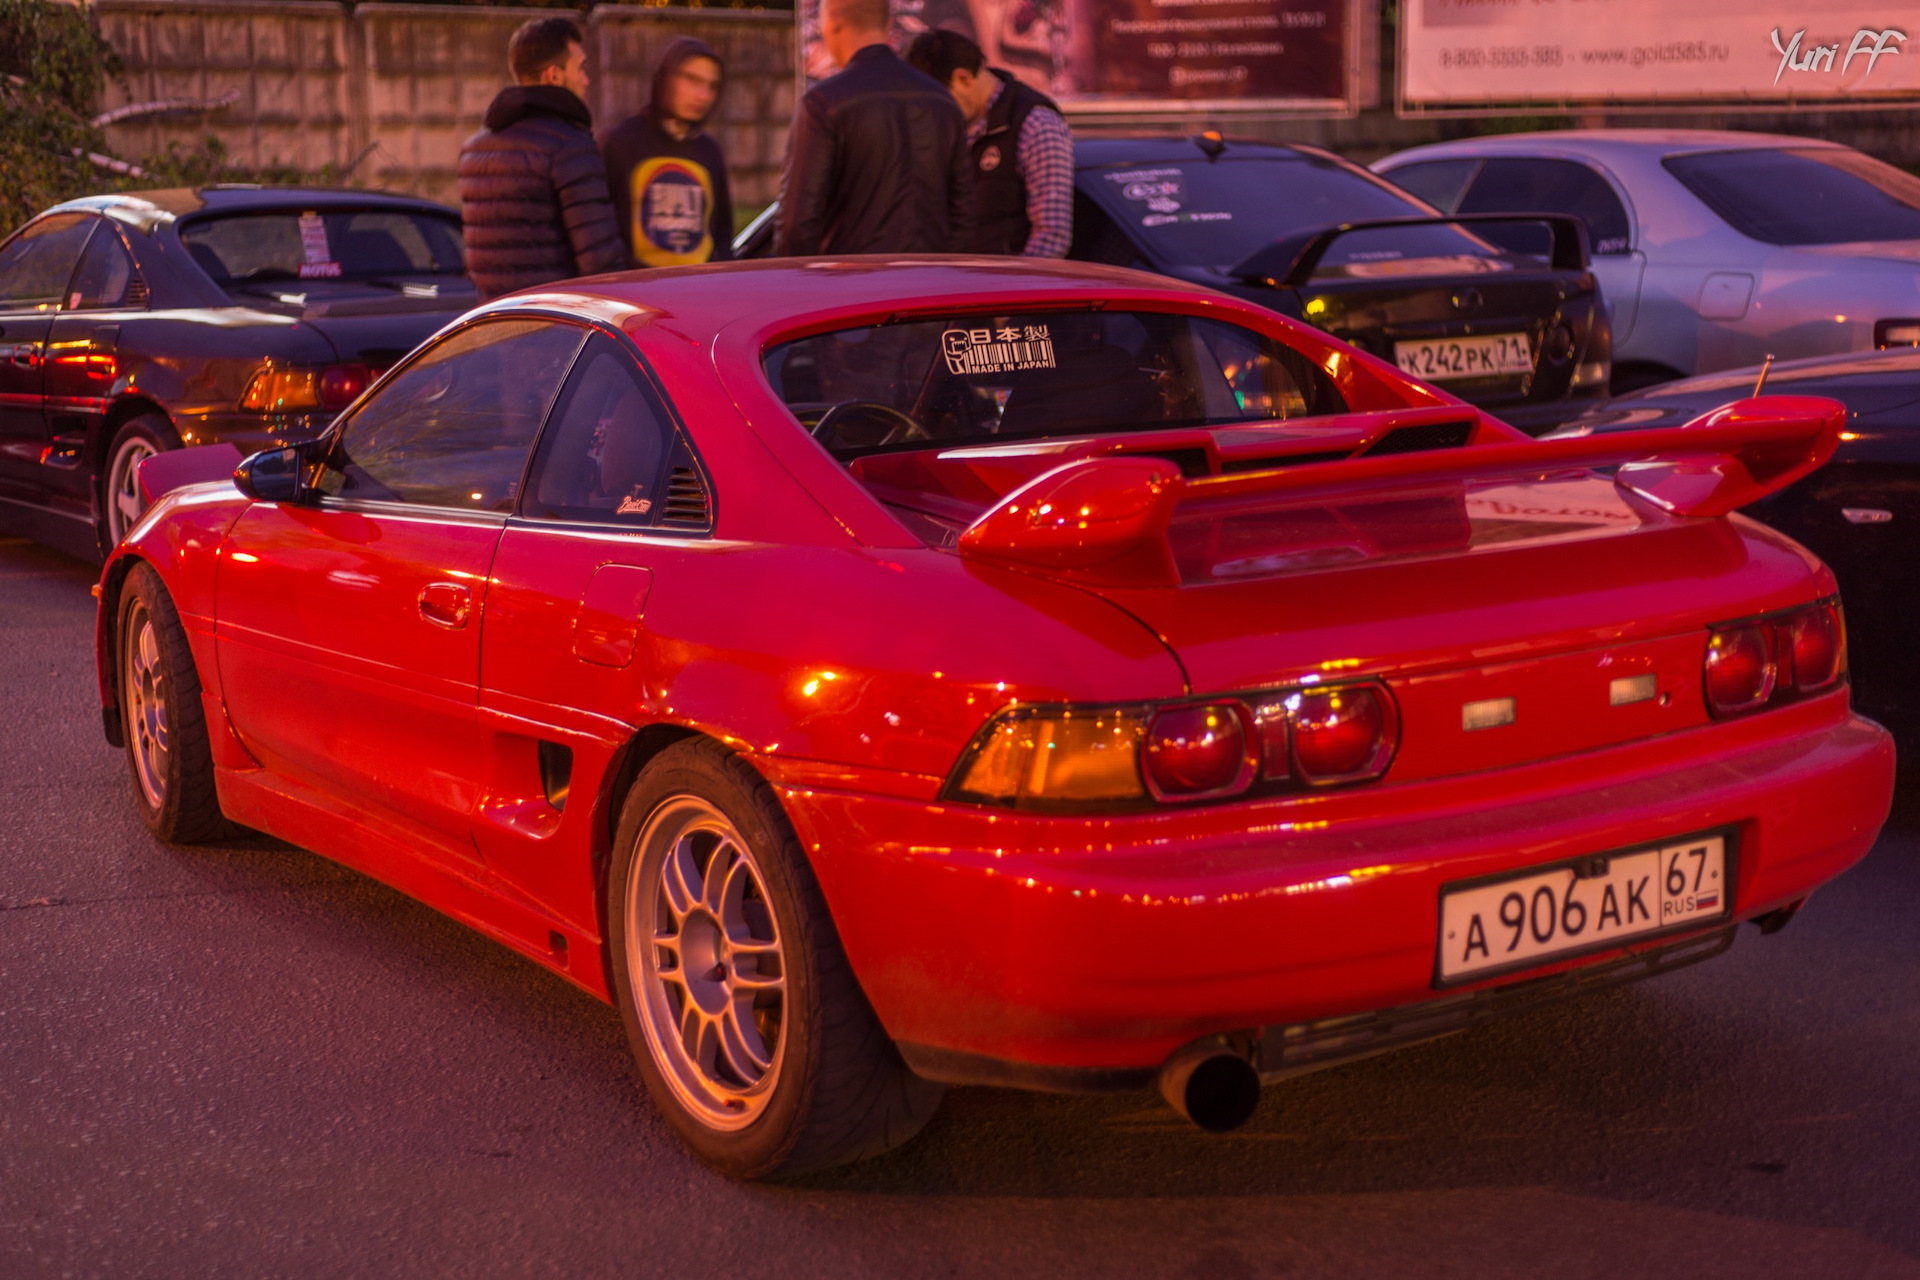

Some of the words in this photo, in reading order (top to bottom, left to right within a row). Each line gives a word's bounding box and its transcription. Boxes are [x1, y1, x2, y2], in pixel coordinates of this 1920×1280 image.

[1580, 41, 1730, 69] www.gold585.ru
[969, 324, 1051, 345] 日本製
[971, 363, 1001, 374] MADE
[1003, 361, 1015, 372] IN
[1017, 359, 1050, 370] JAPAN
[1666, 847, 1707, 896] 67
[1663, 896, 1695, 917] RUS
